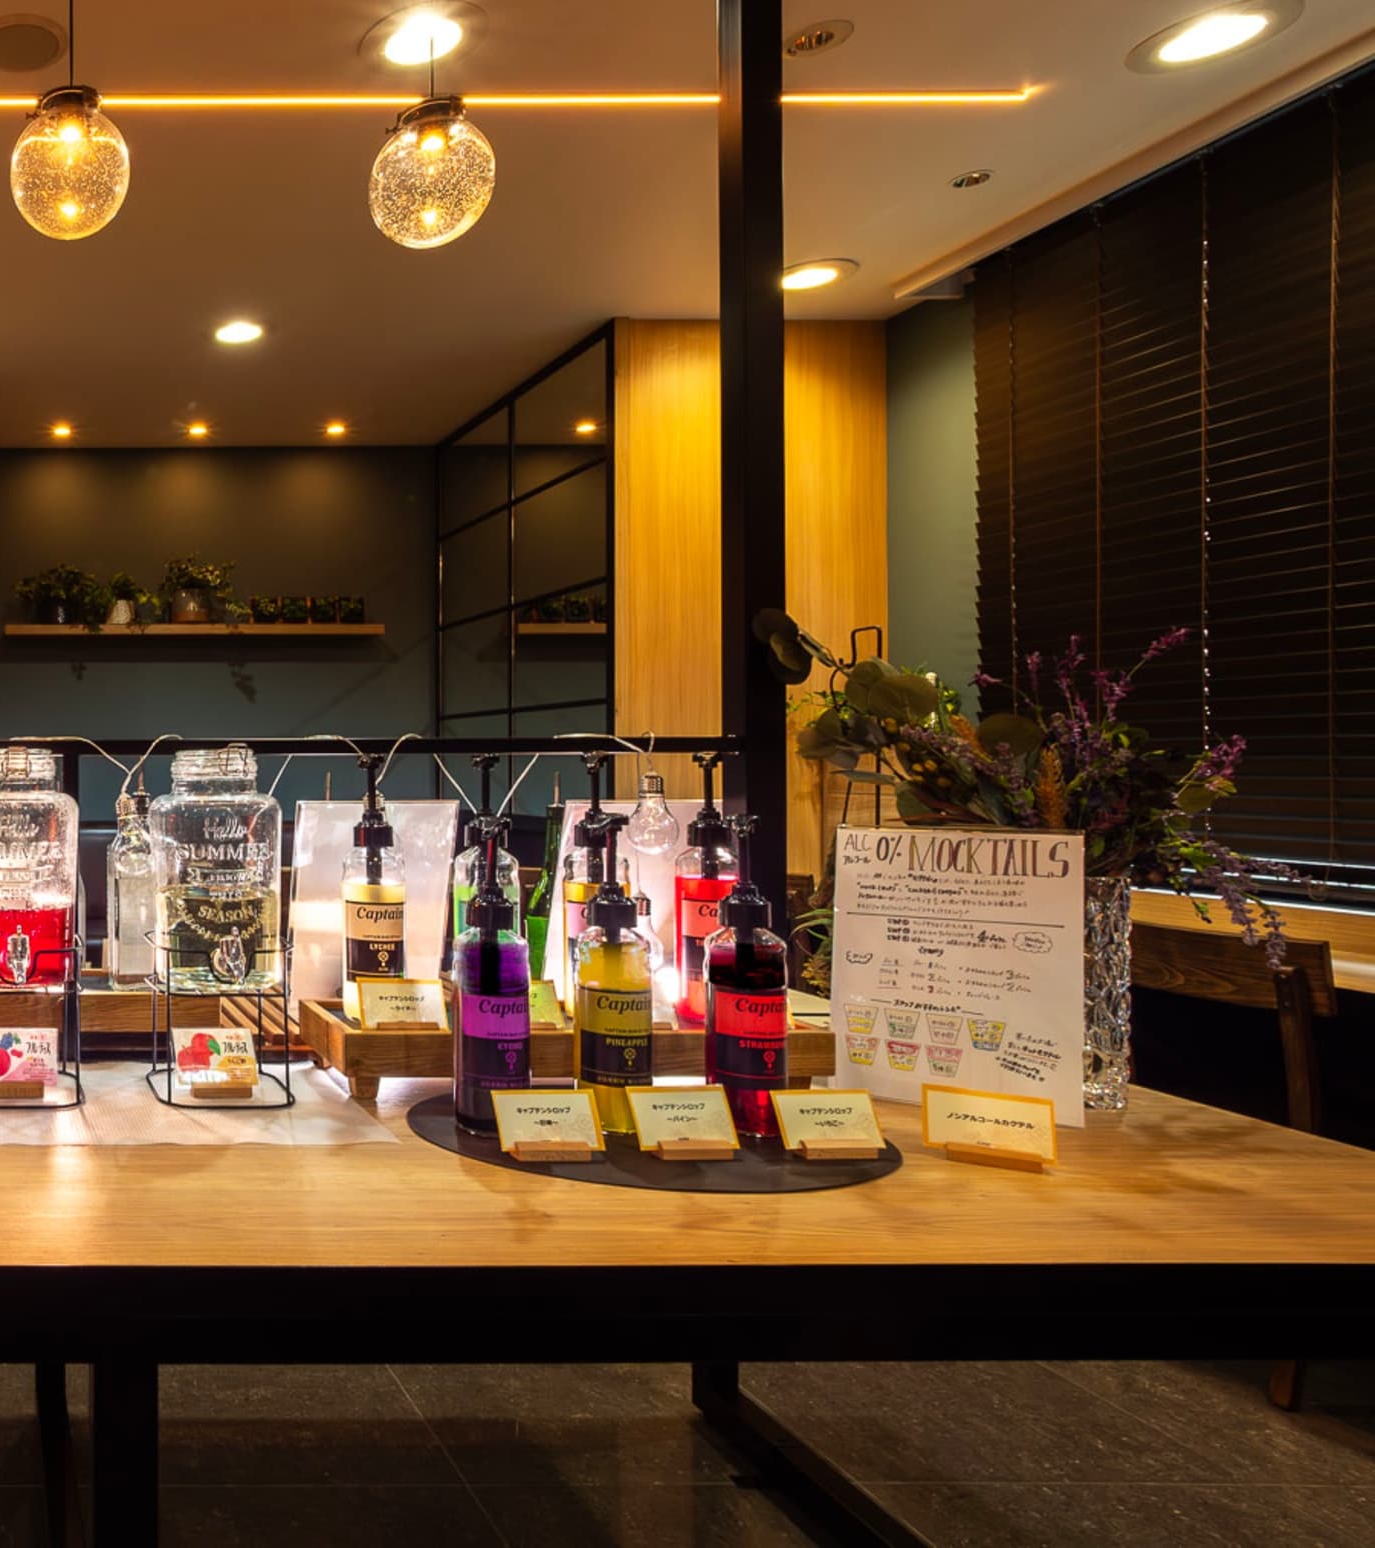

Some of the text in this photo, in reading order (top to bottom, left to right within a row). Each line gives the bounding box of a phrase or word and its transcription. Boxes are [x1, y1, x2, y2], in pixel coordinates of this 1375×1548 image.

[844, 833, 1070, 878] ALC 0% MOCKTAILS
[479, 999, 527, 1018] Capta
[605, 1037, 649, 1047] PINEAPPLE
[516, 1106, 571, 1114] キャプテンシロップ
[652, 1103, 705, 1111] キャプテンシロップ
[799, 1107, 852, 1115] キャプテンシロップ
[946, 1112, 1035, 1130] ノンアルコールカクテル
